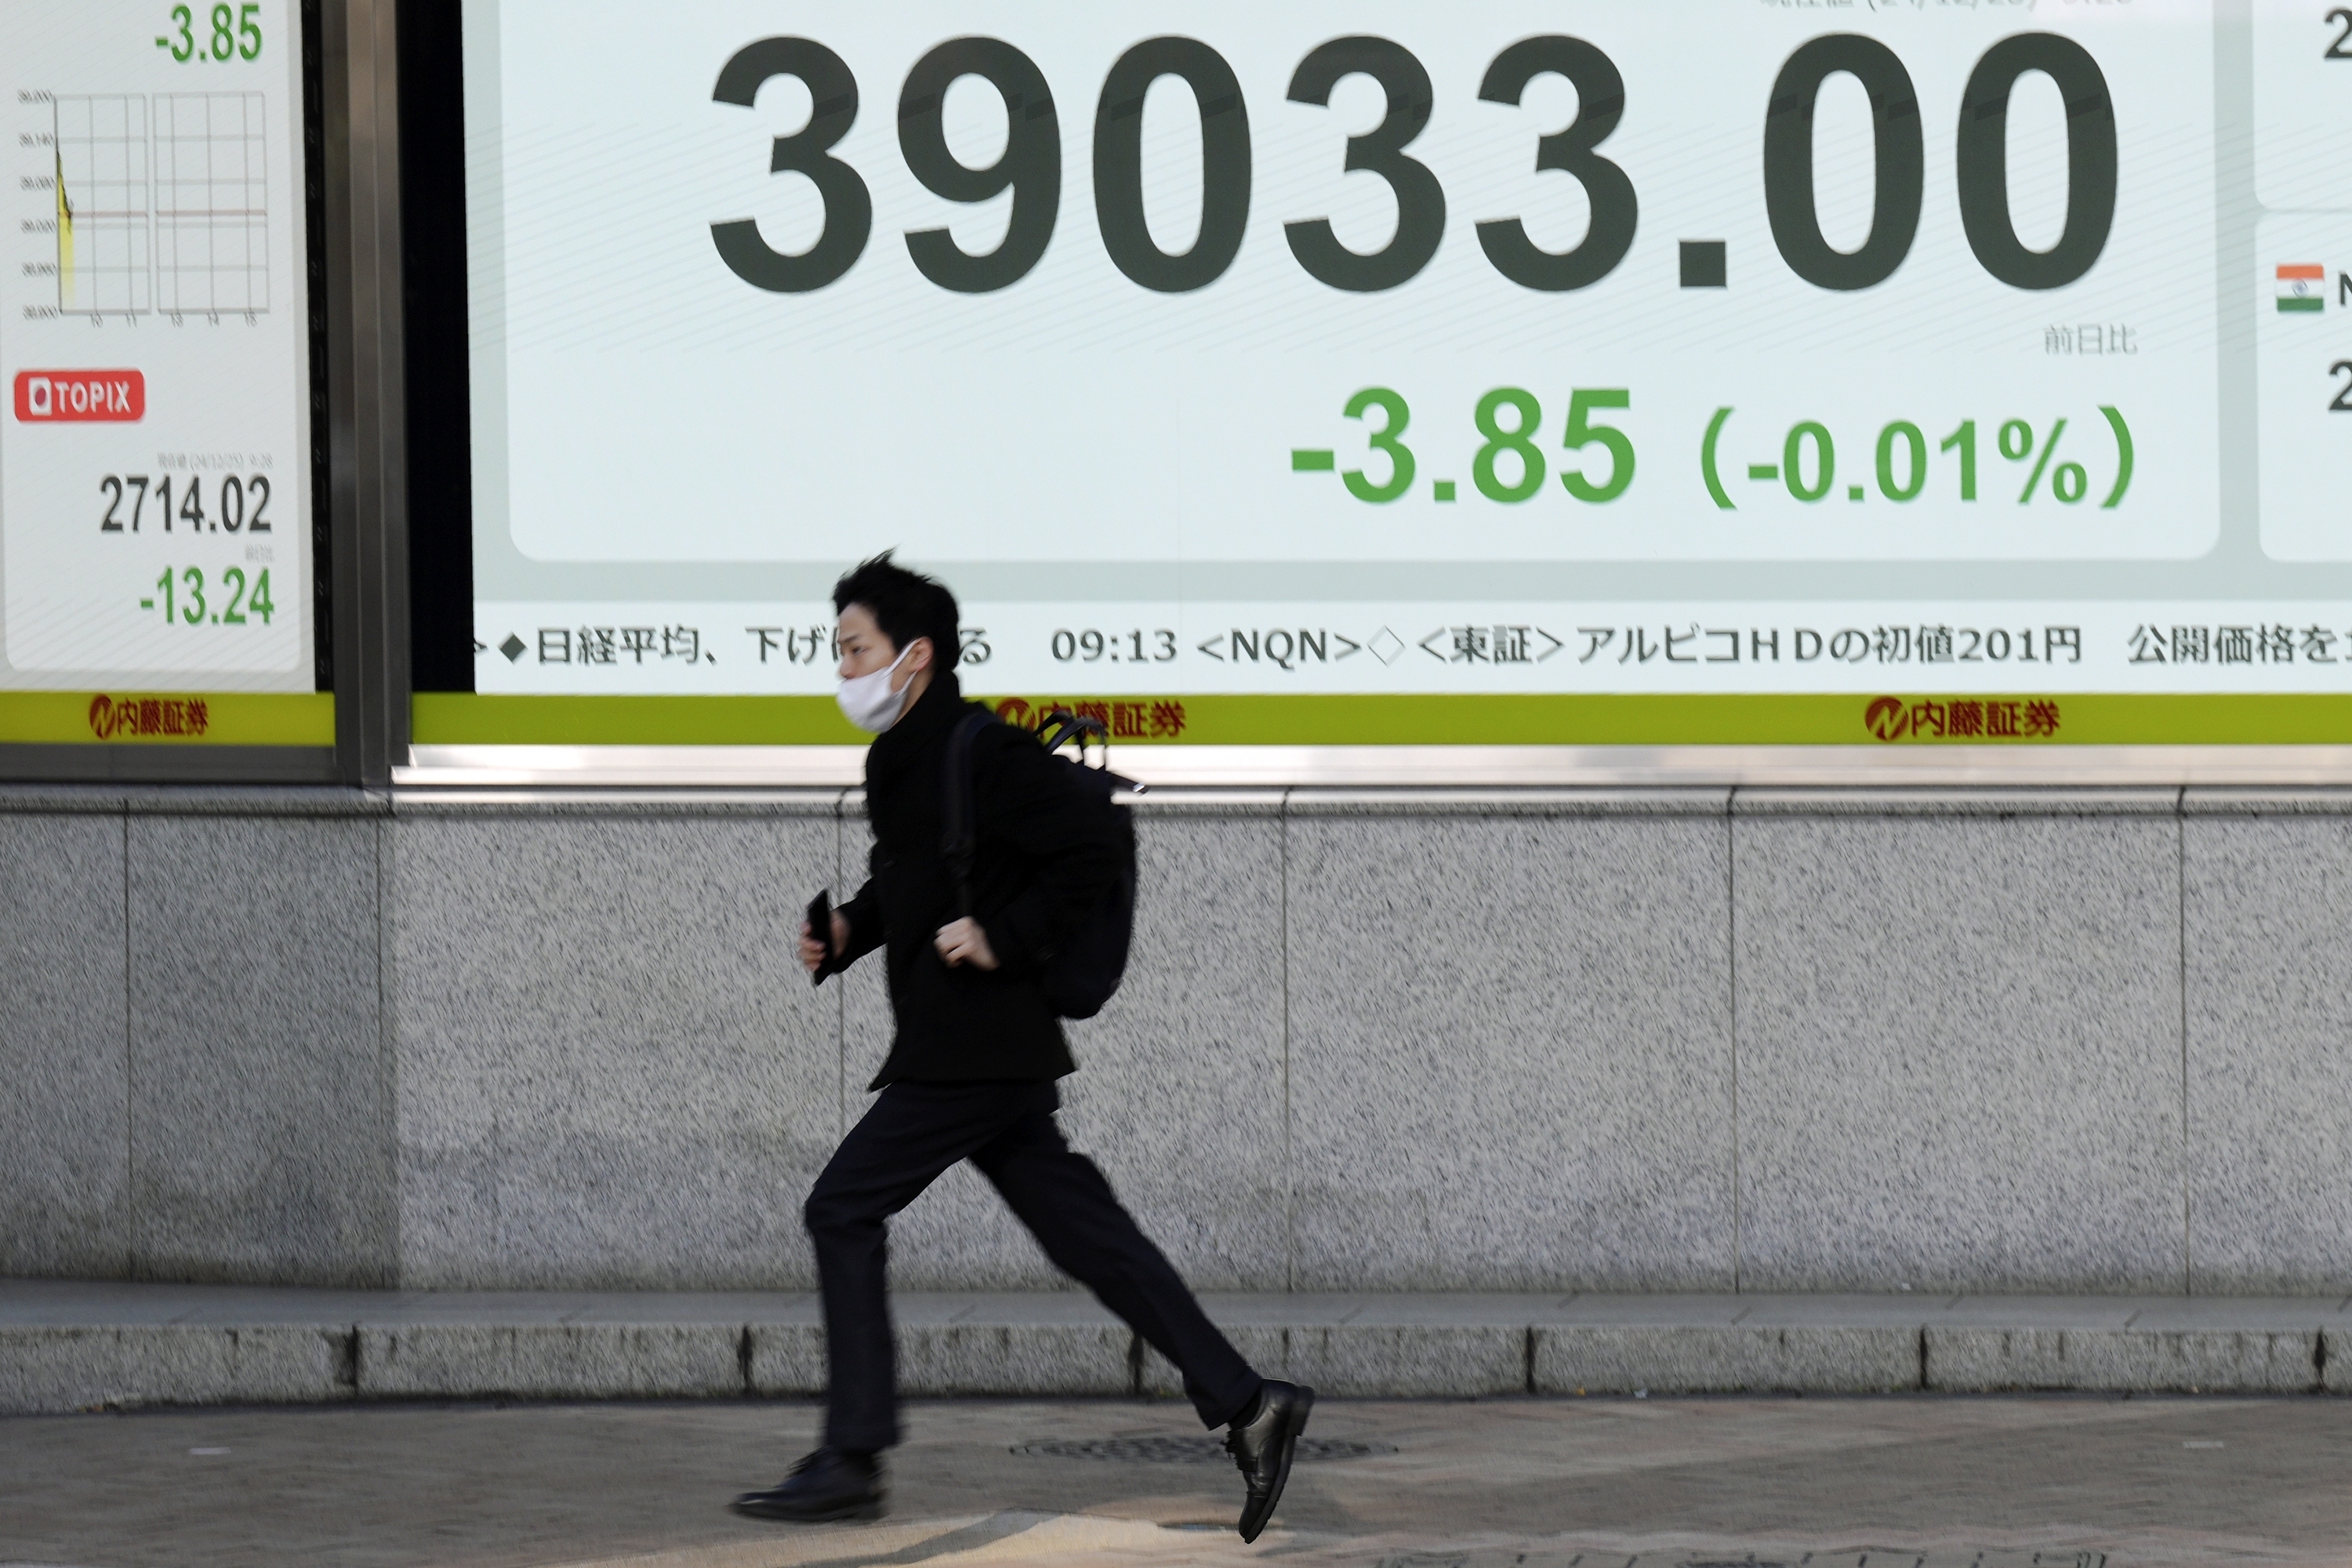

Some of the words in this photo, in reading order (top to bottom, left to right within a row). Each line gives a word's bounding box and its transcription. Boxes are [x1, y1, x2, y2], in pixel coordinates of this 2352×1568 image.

[155, 2, 263, 64] -3.85
[710, 31, 2119, 296] 39033.00
[2044, 323, 2138, 355] 前日比
[54, 381, 132, 413] TOPIX
[1290, 385, 1637, 506] -3.85
[1700, 405, 2135, 511] (-0.01%)
[100, 474, 272, 534] 2714.02
[140, 565, 274, 626] -13.24
[1051, 627, 1177, 665] 09:13
[2128, 623, 2352, 665] 公開価格を
[1911, 699, 2060, 738] 内藤証券
